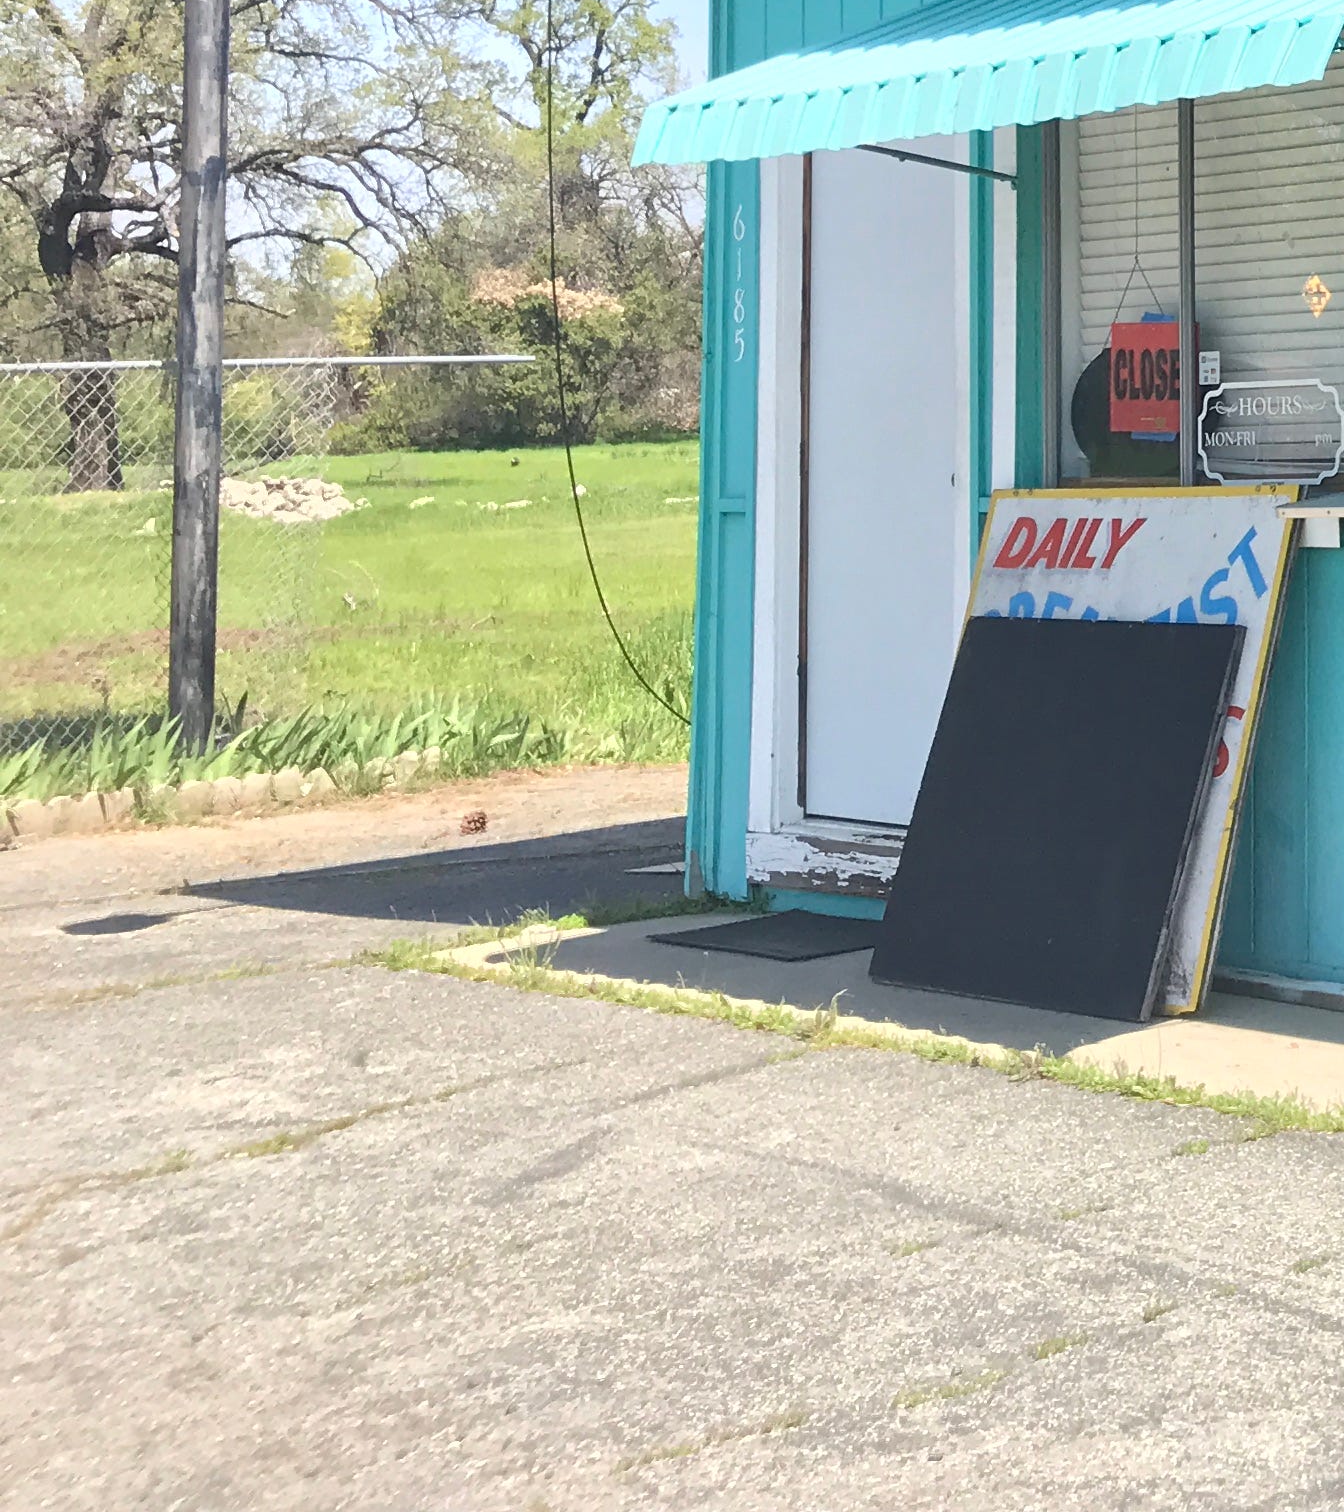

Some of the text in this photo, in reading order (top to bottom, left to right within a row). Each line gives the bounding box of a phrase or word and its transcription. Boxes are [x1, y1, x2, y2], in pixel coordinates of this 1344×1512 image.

[732, 203, 746, 363] 6185
[1113, 348, 1181, 401] CLOSE
[1239, 394, 1303, 416] HOURS
[1314, 432, 1333, 448] pm
[993, 516, 1148, 570] DAILY
